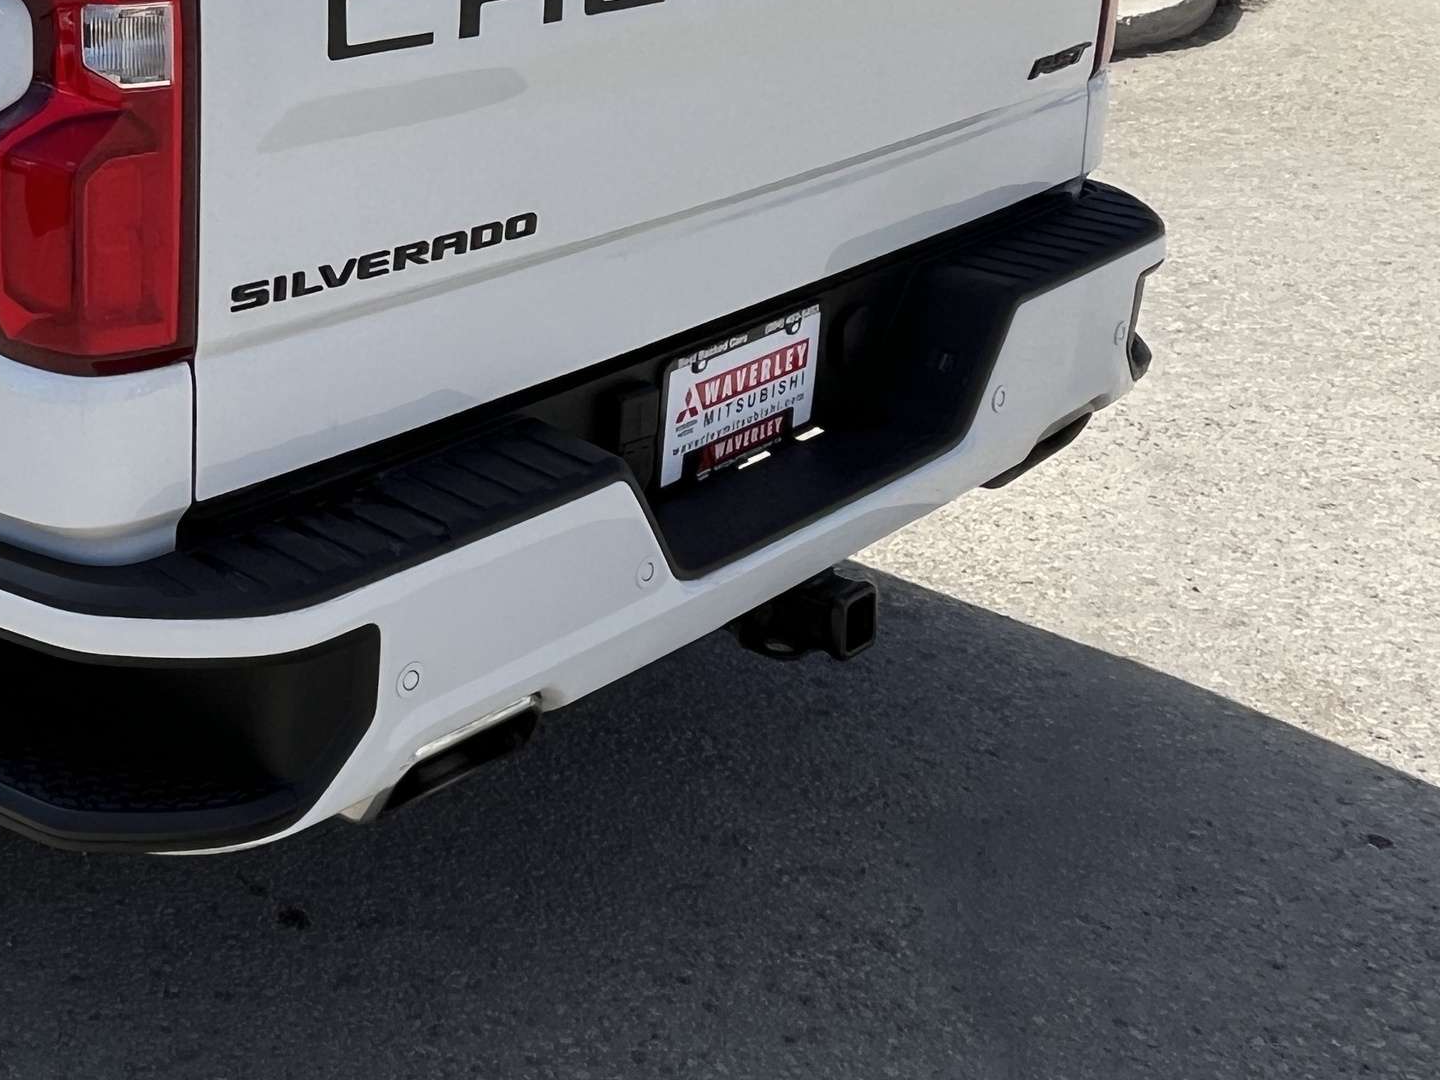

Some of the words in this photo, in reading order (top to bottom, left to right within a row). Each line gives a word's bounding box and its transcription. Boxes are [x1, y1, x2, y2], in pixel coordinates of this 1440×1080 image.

[230, 212, 537, 312] SILVERADO
[703, 342, 808, 405] WAVERLEY
[703, 375, 805, 427] MITSUBISHI
[714, 416, 783, 460] WAVERLEY
